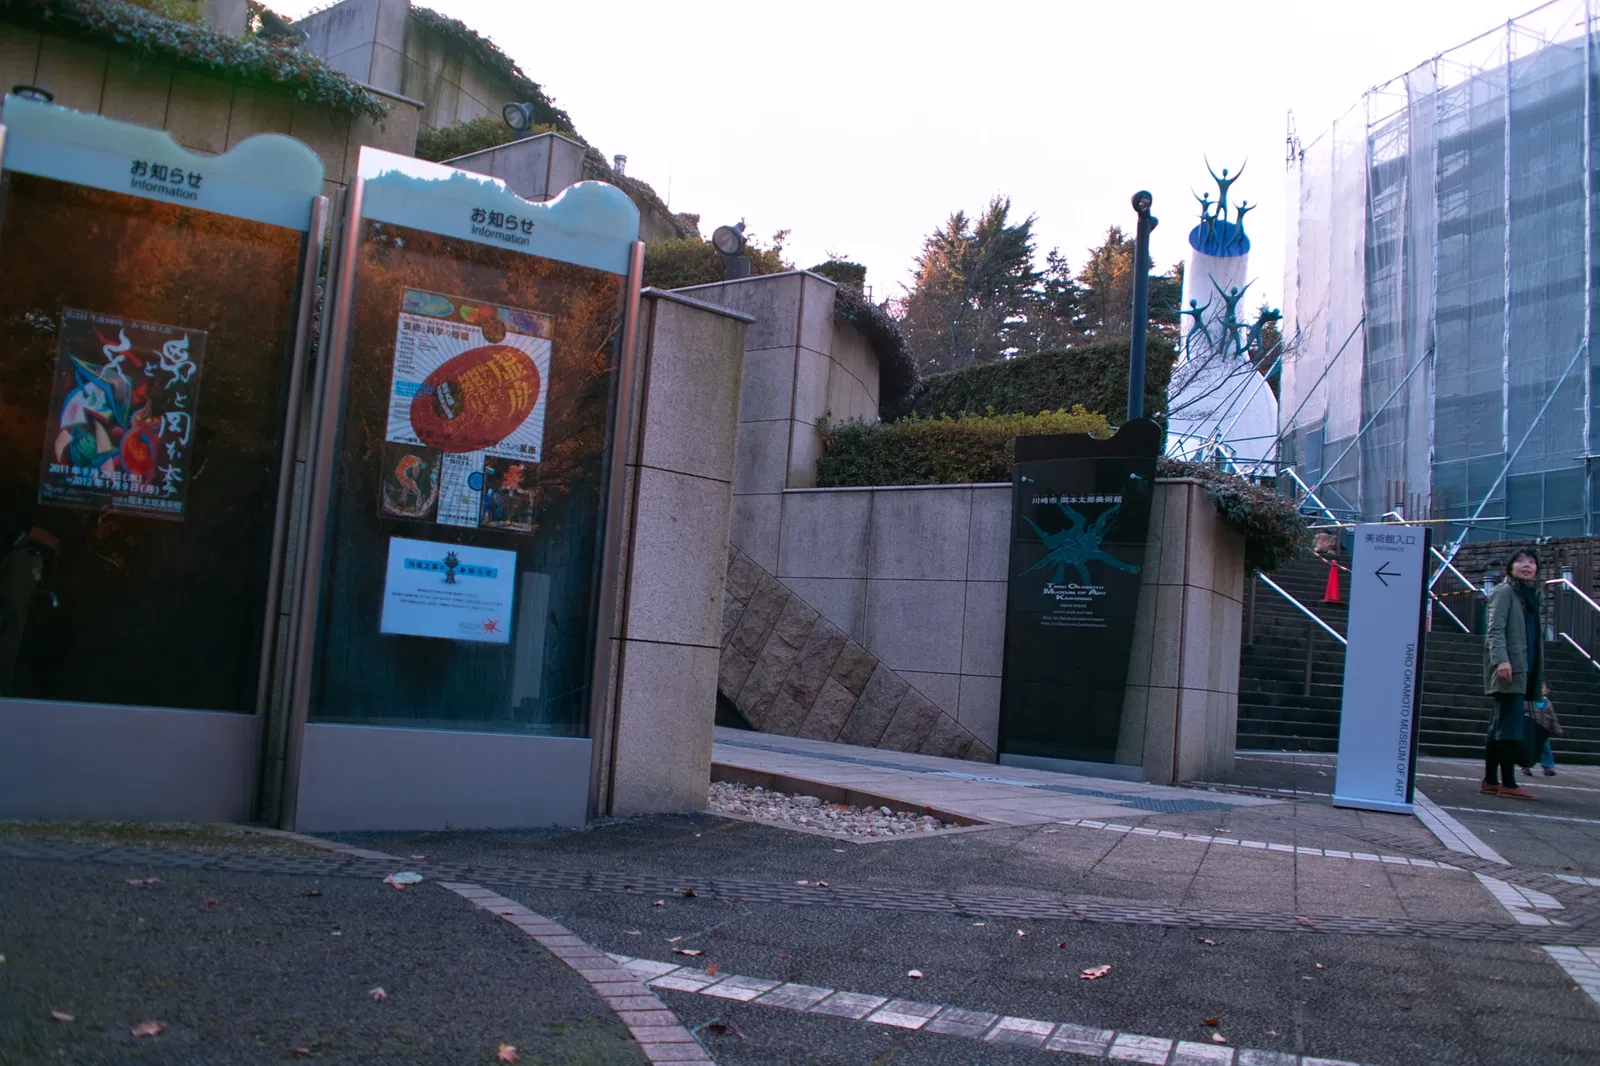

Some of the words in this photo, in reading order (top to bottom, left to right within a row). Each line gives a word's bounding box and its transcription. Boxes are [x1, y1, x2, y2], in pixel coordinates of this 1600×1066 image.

[130, 159, 203, 189] お知らせ
[131, 177, 197, 200] Information
[471, 207, 535, 235] お知らせ
[471, 224, 530, 246] Information
[1365, 533, 1416, 545] 美術館入口
[1404, 642, 1415, 668] TARO
[1401, 669, 1413, 717] OKAMOTO
[1397, 719, 1409, 761] MUSEUM
[1396, 763, 1406, 776] OF
[1394, 778, 1405, 799] ART
